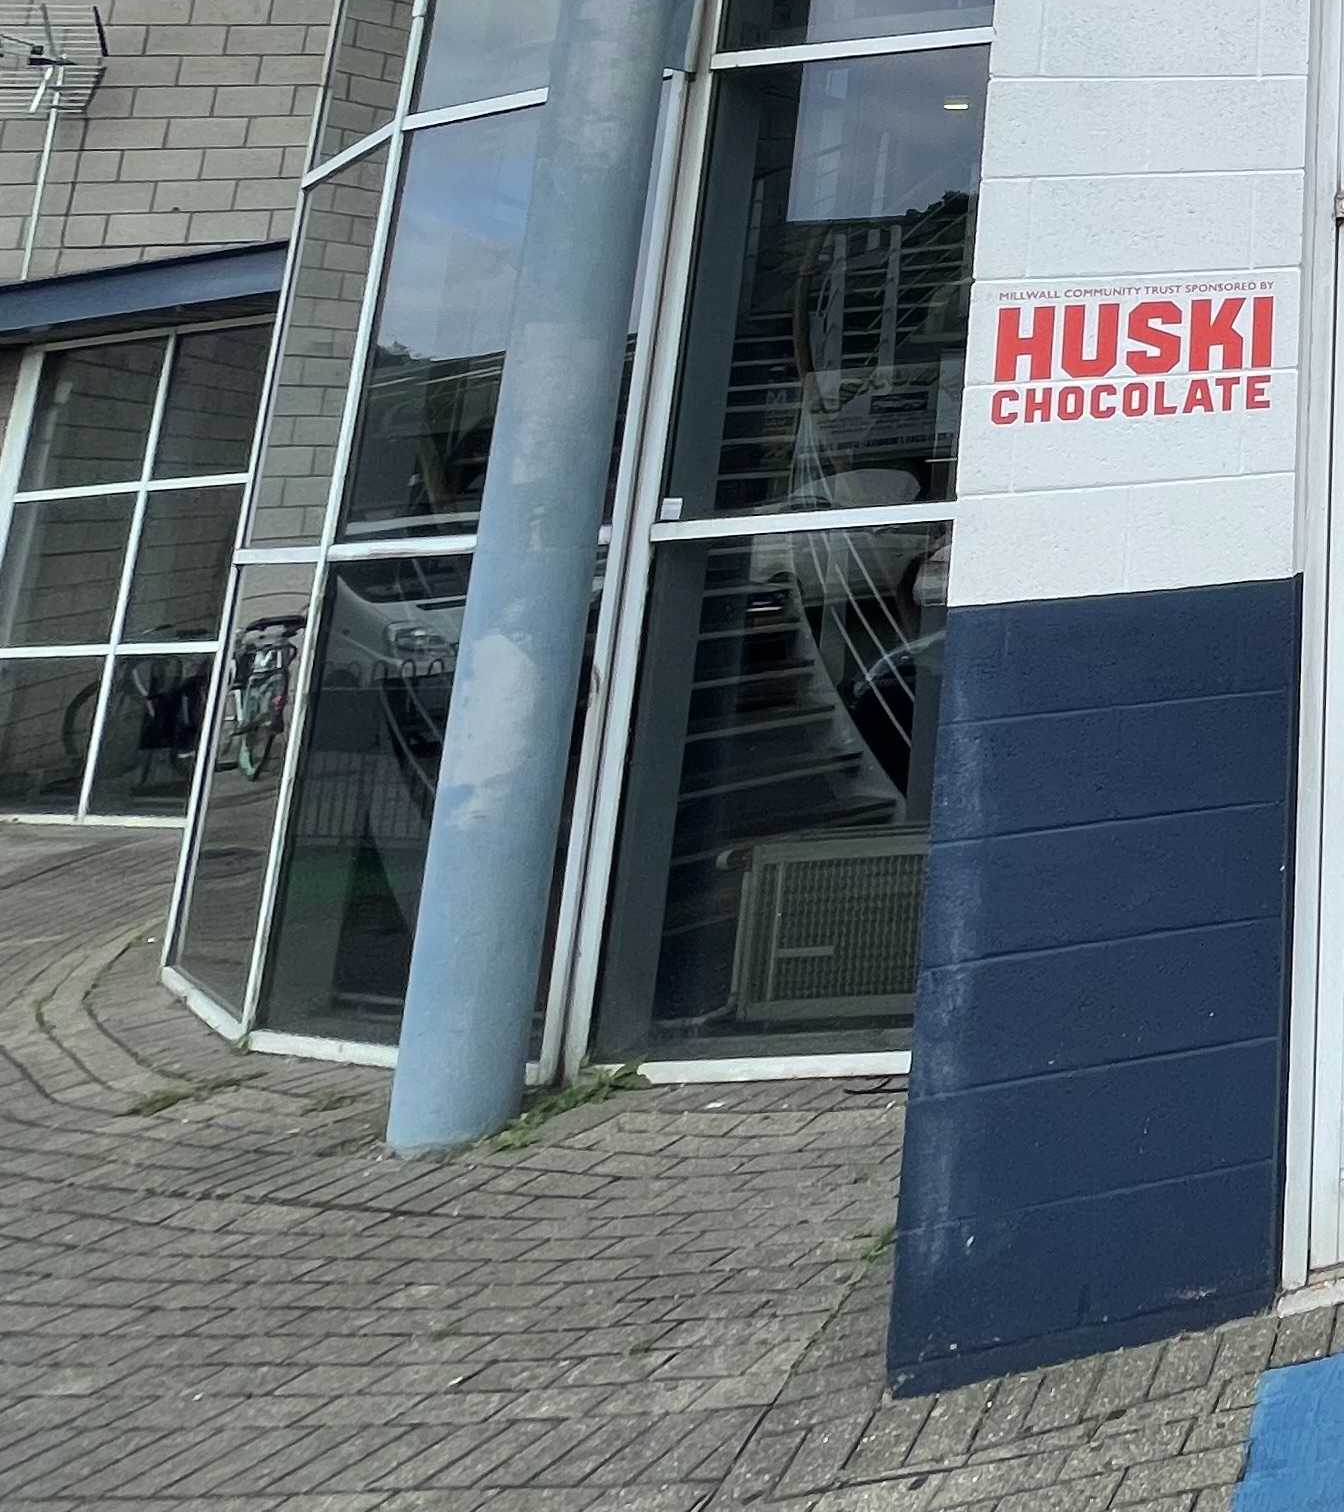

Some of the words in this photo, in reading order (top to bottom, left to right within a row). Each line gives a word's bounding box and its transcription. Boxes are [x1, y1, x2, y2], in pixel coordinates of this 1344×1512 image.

[999, 288, 1060, 302] MILLWALL
[1064, 287, 1142, 299] COMMUNITY
[1144, 284, 1182, 295] TRUST
[1184, 281, 1257, 293] SPONSORED
[1259, 280, 1275, 290] BY
[994, 296, 1274, 383] HUSKI
[990, 375, 1271, 425] CHOCOLATE
